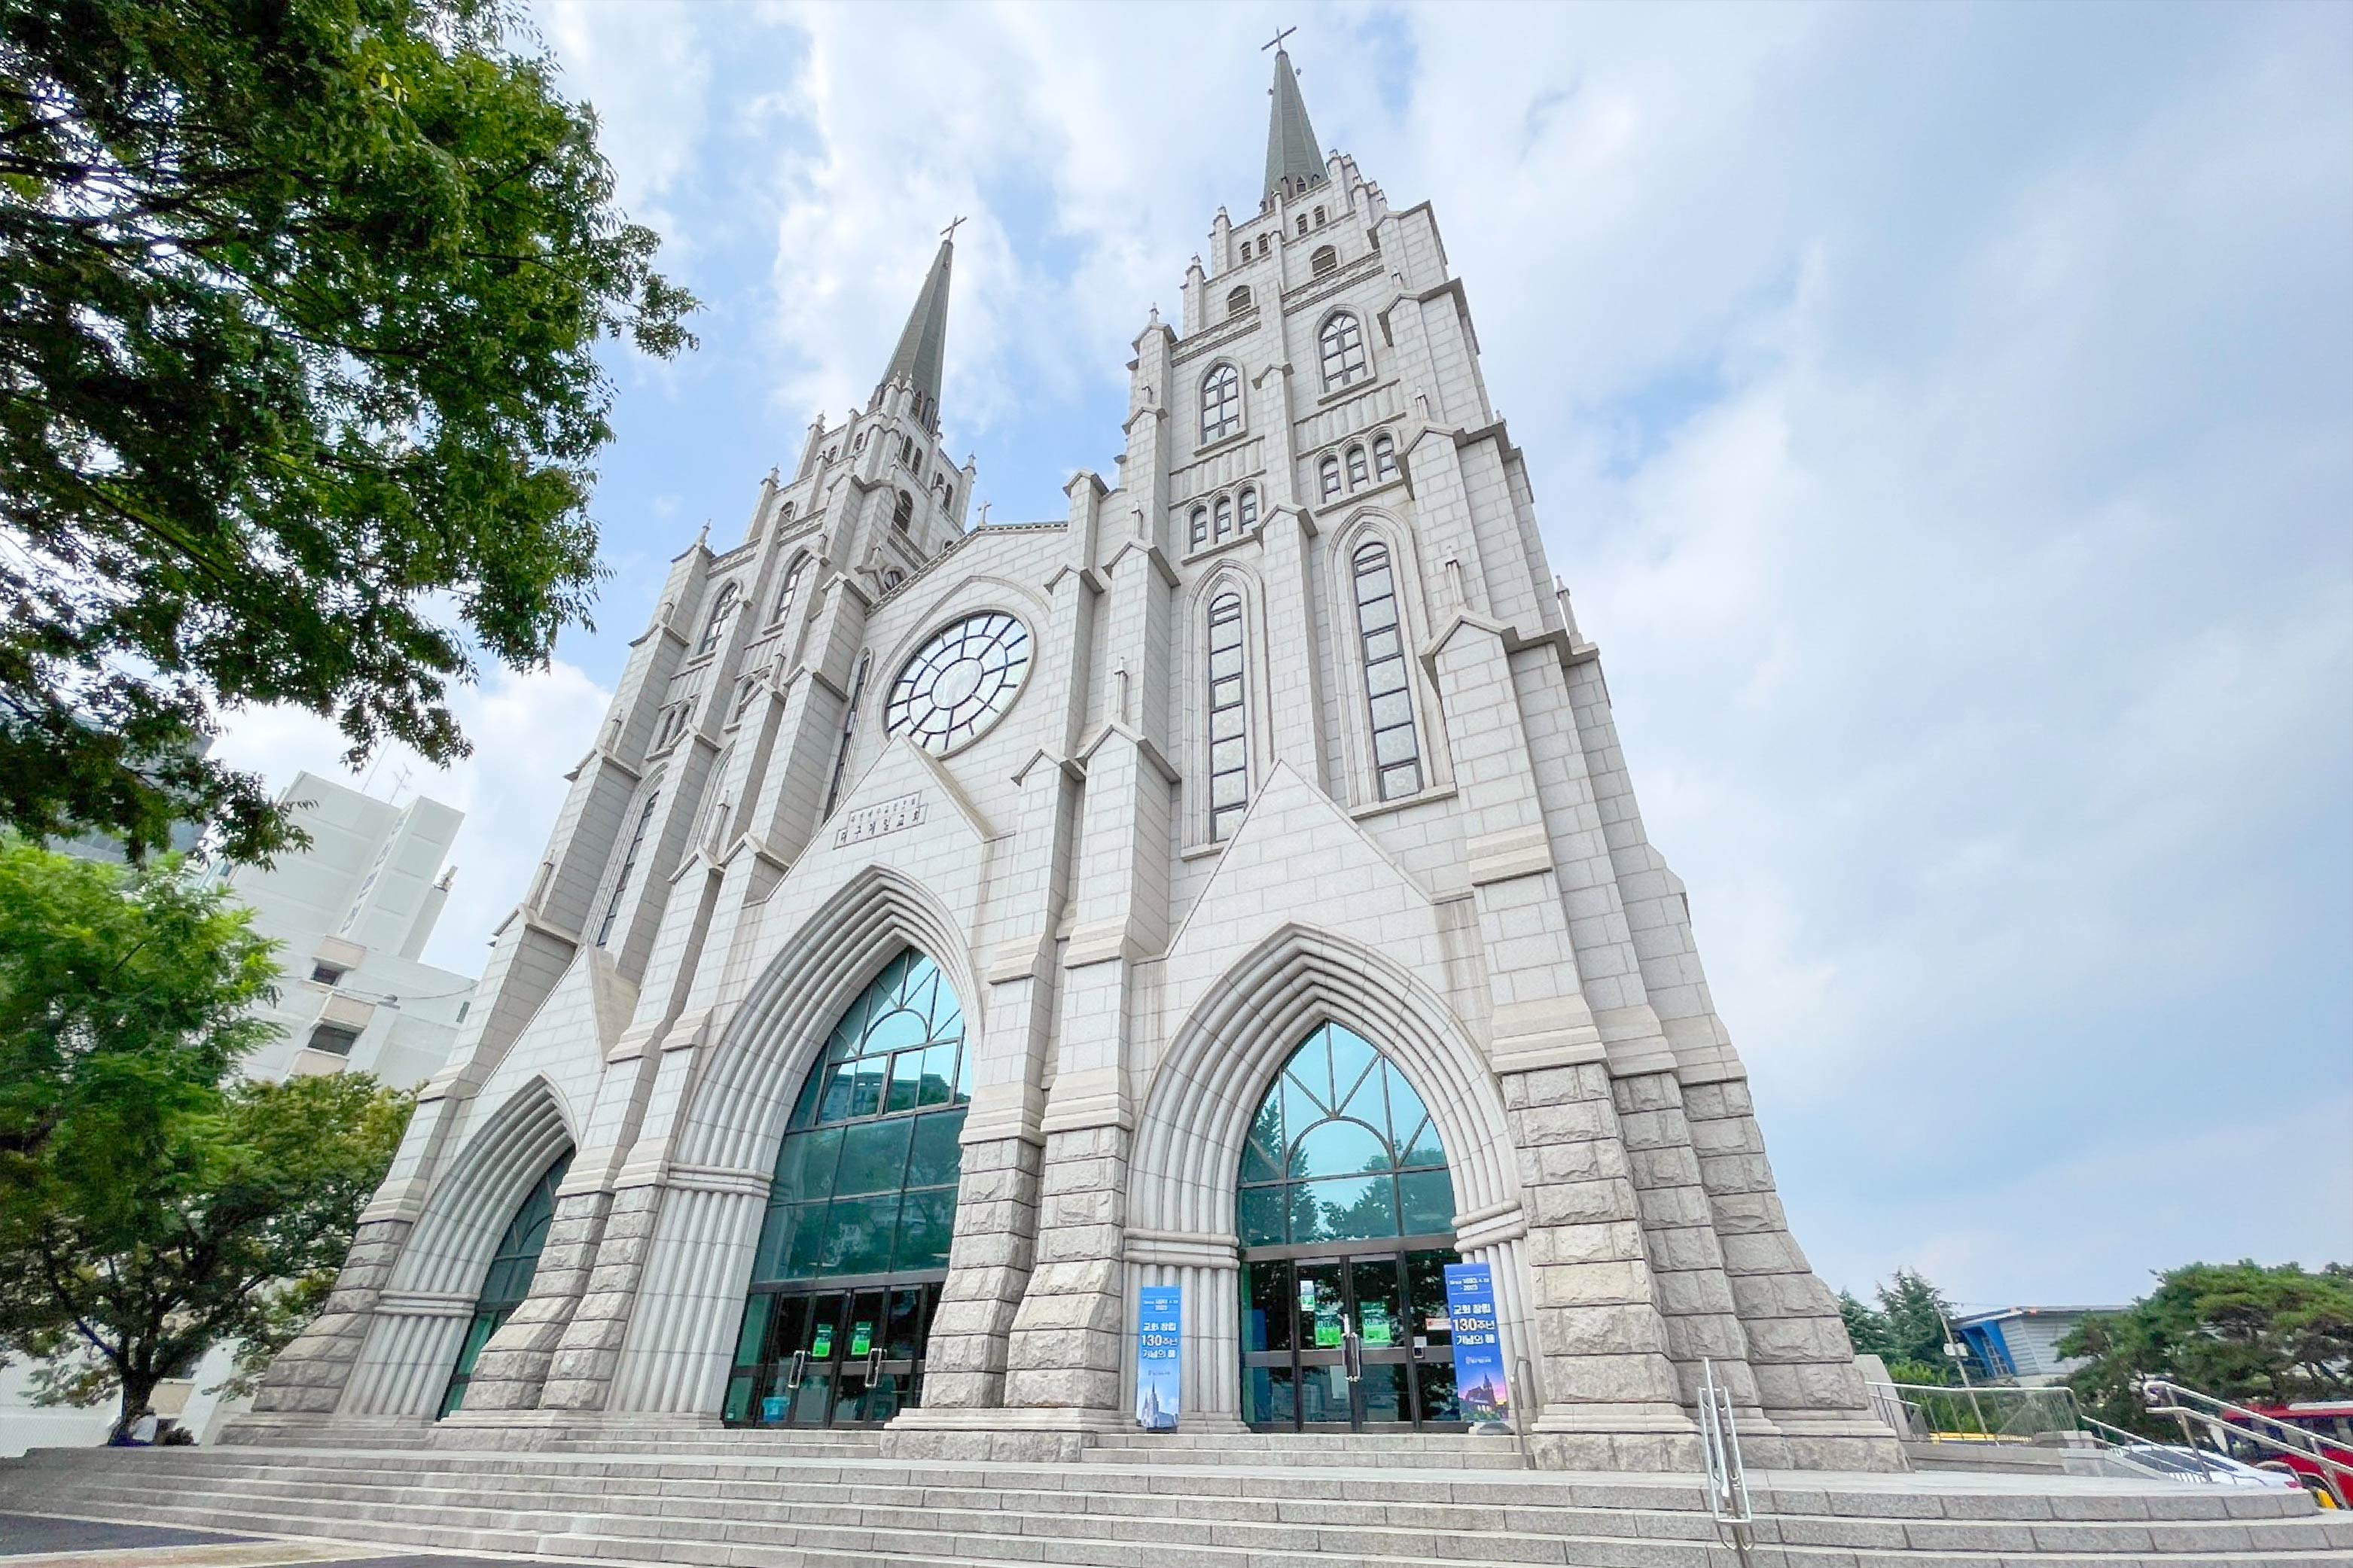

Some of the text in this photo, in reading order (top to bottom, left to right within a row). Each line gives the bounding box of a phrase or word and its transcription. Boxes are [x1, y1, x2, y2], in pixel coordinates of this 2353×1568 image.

[840, 810, 919, 843] 대구제일교회
[1453, 1303, 1491, 1314] 교회 창립
[1143, 1322, 1159, 1331] 교회
[1452, 1318, 1495, 1332] 130주년
[1141, 1335, 1178, 1346] 130주년
[1456, 1335, 1484, 1345] 기념의
